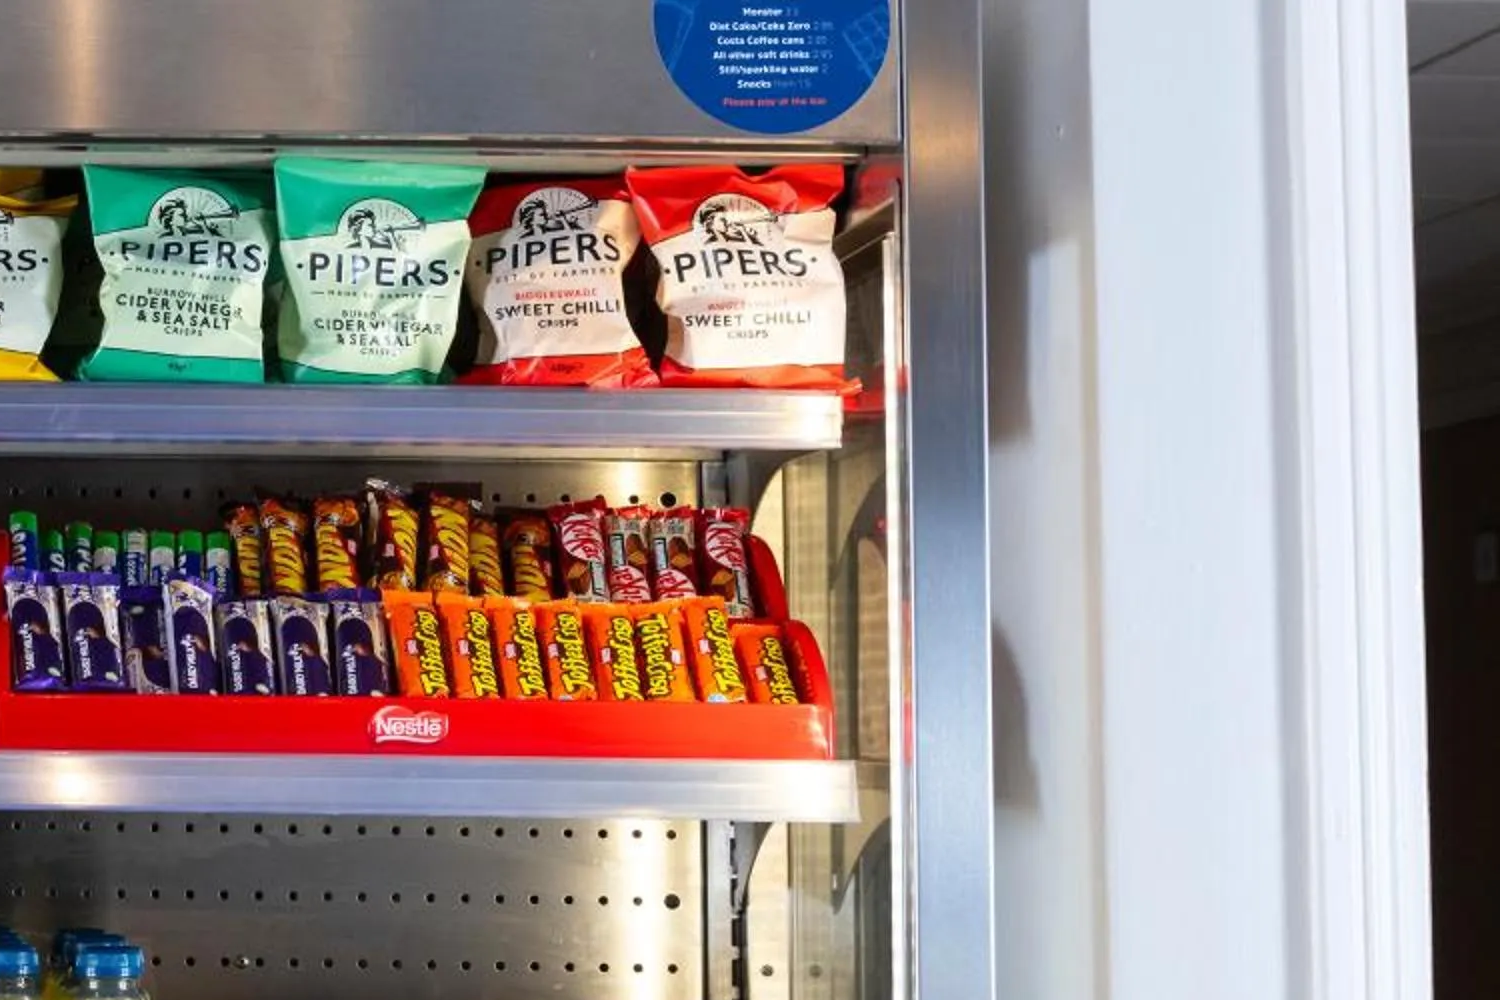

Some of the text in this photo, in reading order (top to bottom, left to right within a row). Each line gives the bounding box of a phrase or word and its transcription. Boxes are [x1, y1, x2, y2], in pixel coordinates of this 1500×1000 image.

[787, 21, 811, 31] Zero
[747, 36, 779, 45] Coffee
[779, 51, 810, 59] drinks
[737, 79, 772, 89] Snacks
[121, 239, 263, 273] PIPERS
[486, 232, 621, 275] PIPERS
[308, 252, 450, 287] PIPERS
[673, 247, 808, 283] PIPERS
[116, 293, 170, 310] CIDER
[495, 298, 621, 321] SWEET CHILLI
[136, 310, 232, 331] & SEA SALT
[314, 317, 444, 337] CIDER VIEGAR
[537, 318, 579, 329] CRISPS
[685, 311, 811, 328] SWEET CHILLI
[349, 334, 380, 346] SEA
[636, 612, 668, 665] Toffee
[472, 642, 499, 696] Toffee
[518, 642, 547, 695] Toffee
[560, 642, 596, 692] Toffee
[714, 639, 746, 692] Toffee
